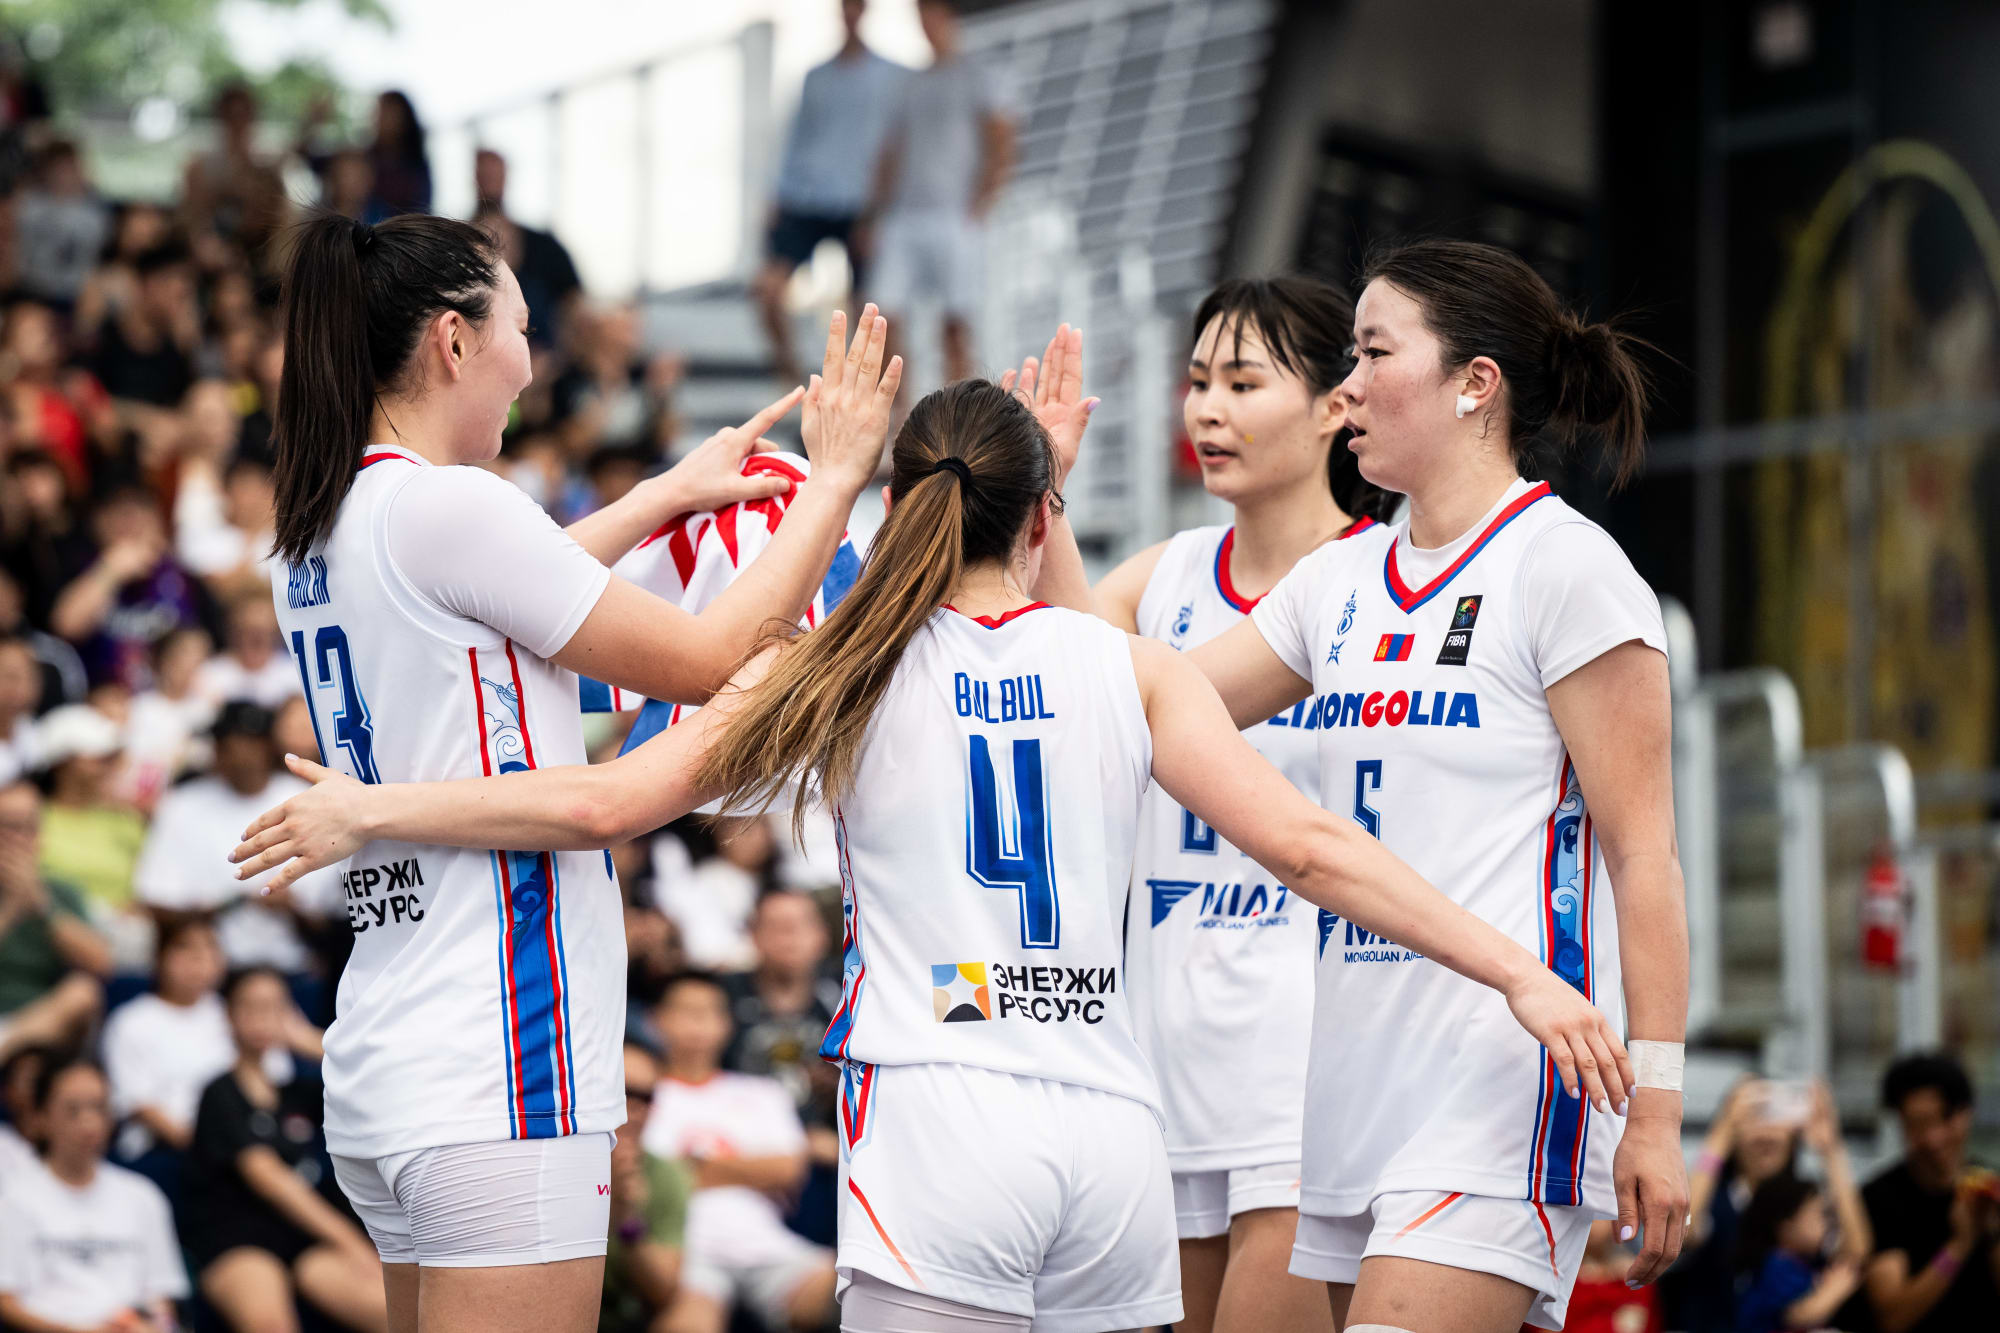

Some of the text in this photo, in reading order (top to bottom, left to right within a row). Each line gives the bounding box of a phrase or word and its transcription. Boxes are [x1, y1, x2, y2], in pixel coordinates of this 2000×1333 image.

[1446, 635, 1467, 647] FIBA
[291, 625, 382, 785] 13
[1353, 759, 1384, 841] 5
[966, 735, 1060, 949] 4
[341, 858, 424, 899] НЕРЖИ
[348, 894, 424, 933] ЕСУРС
[1344, 951, 1400, 963] MONGOLIAN
[993, 963, 1115, 994] ЭНЕРЖИ
[998, 993, 1105, 1024] РЕСУРС
